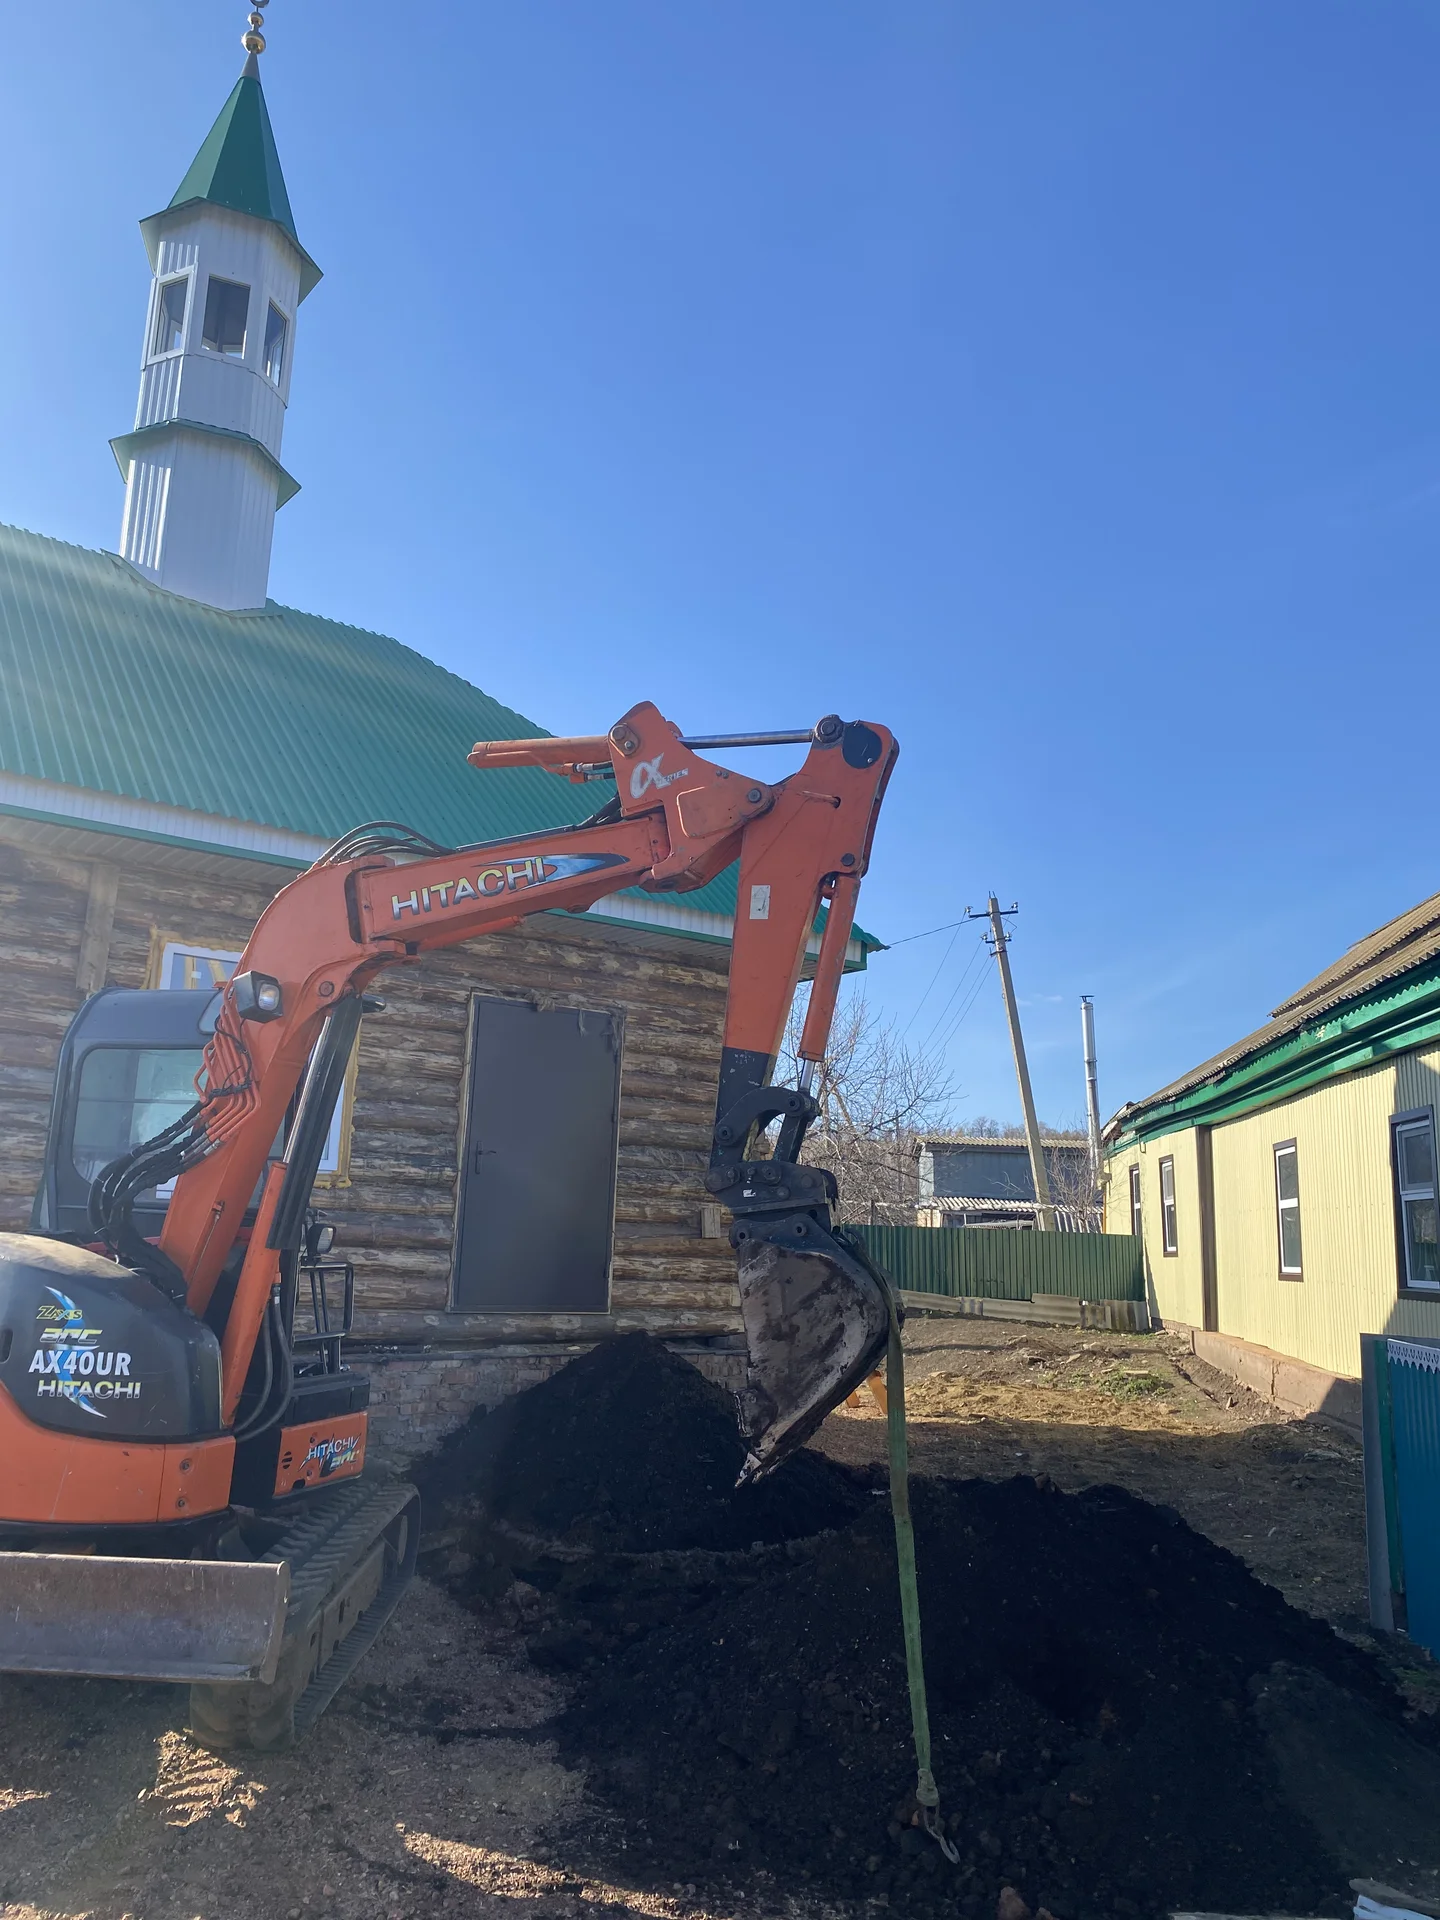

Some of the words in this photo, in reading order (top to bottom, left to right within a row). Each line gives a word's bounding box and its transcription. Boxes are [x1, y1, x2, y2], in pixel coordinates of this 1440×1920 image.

[391, 857, 546, 920] HITACHI
[28, 1350, 131, 1376] AX40UR
[37, 1380, 141, 1399] HITACHI
[308, 1436, 355, 1460] HITACHI
